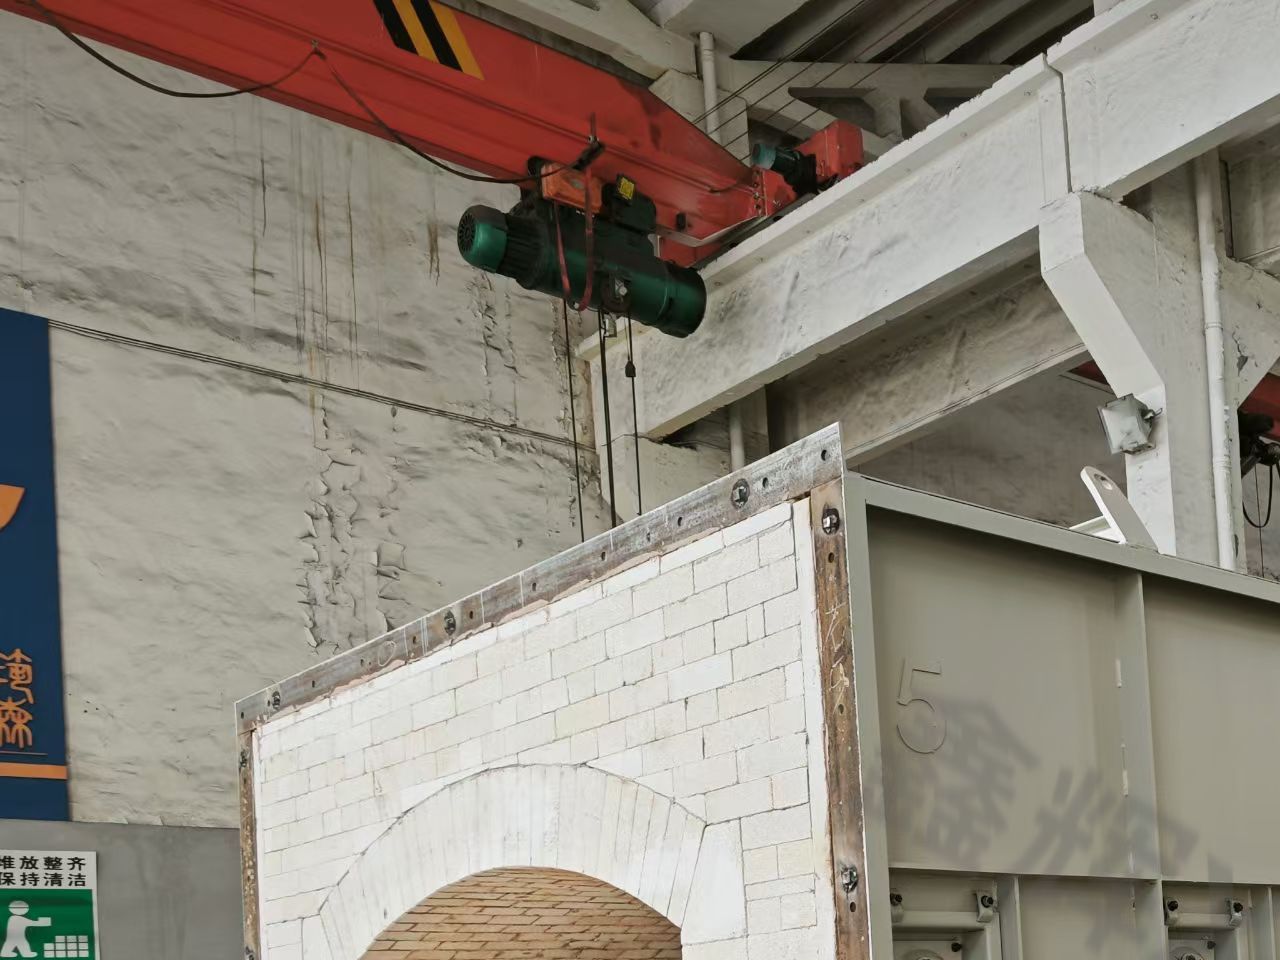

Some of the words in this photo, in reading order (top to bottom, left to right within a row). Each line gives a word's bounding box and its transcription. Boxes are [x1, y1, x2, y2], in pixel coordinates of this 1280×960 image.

[895, 656, 948, 755] 5
[0, 855, 87, 871] 堆放整齐
[0, 872, 87, 887] 保持清洁
